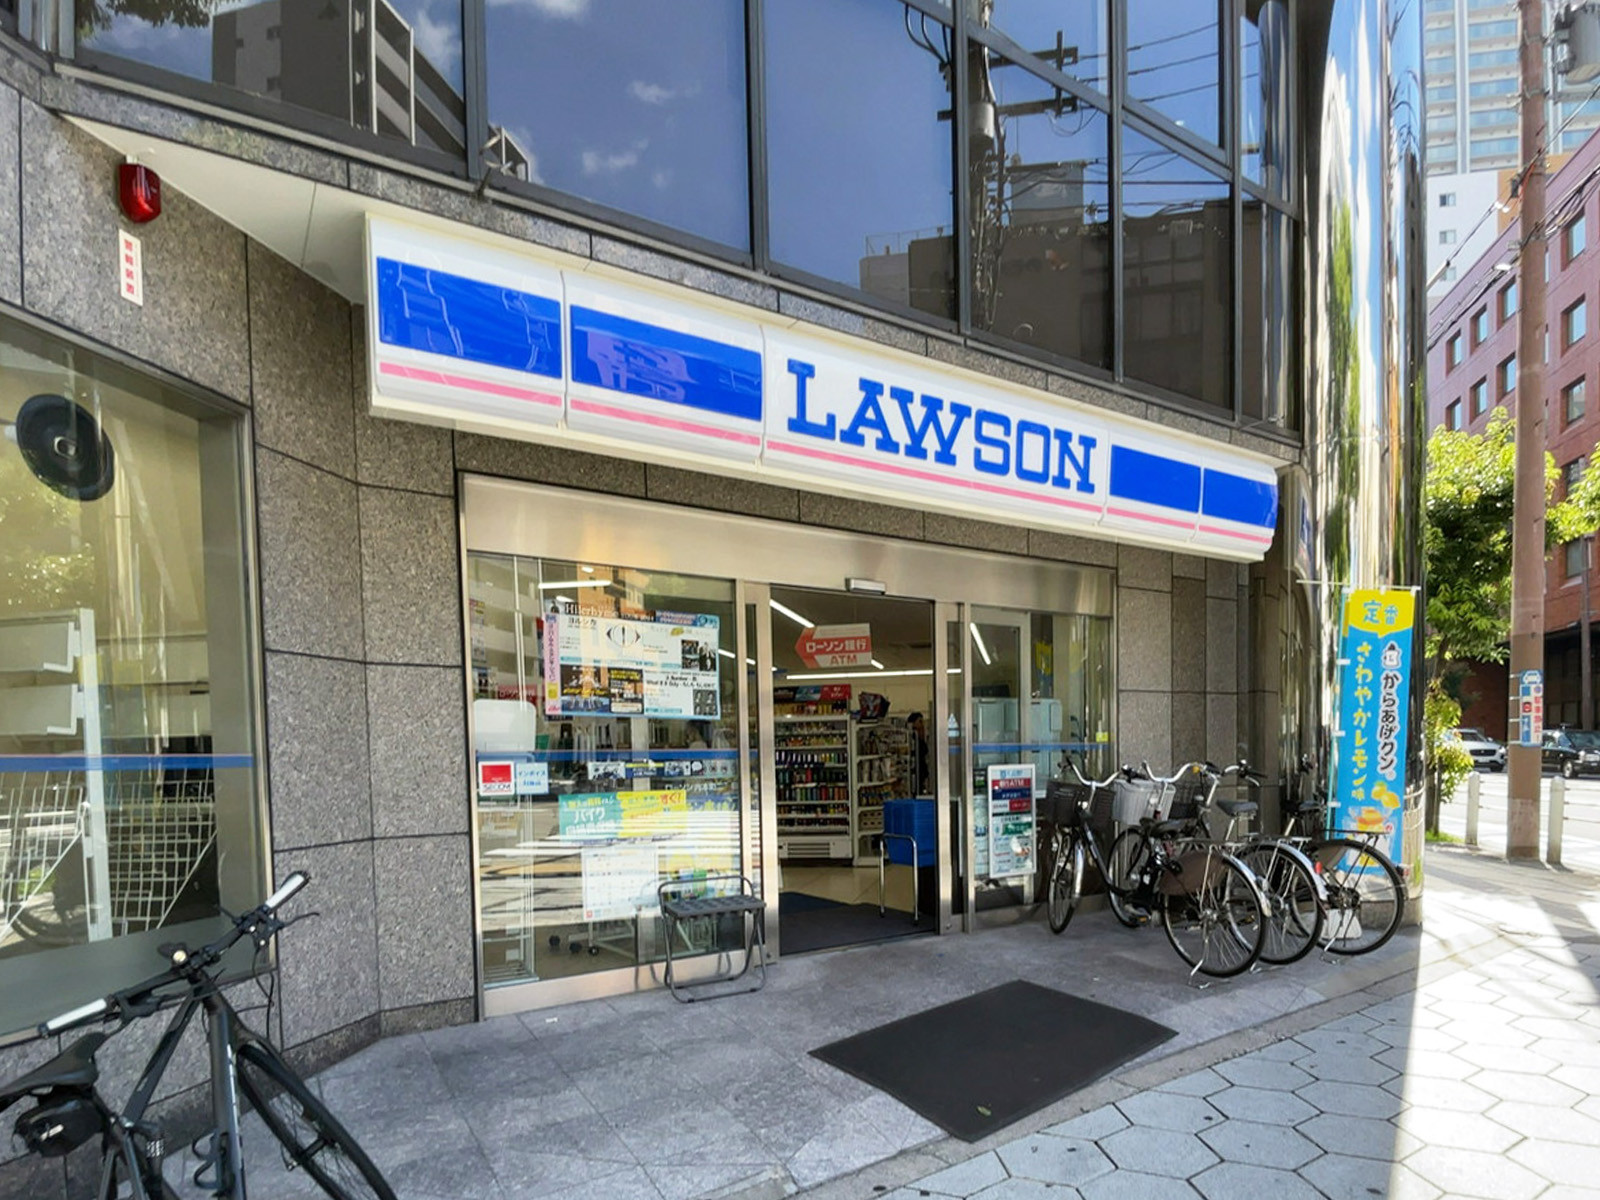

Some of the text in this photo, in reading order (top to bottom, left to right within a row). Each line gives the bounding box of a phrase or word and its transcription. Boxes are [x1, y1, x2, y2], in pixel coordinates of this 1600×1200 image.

[787, 358, 1097, 494] LAWSON
[1363, 599, 1399, 625] 定番
[805, 638, 867, 653] ローソン銀行
[830, 654, 857, 665] ATM
[1351, 641, 1374, 801] さわやかレモン味
[483, 783, 511, 792] SECOM
[573, 808, 606, 824] バイク
